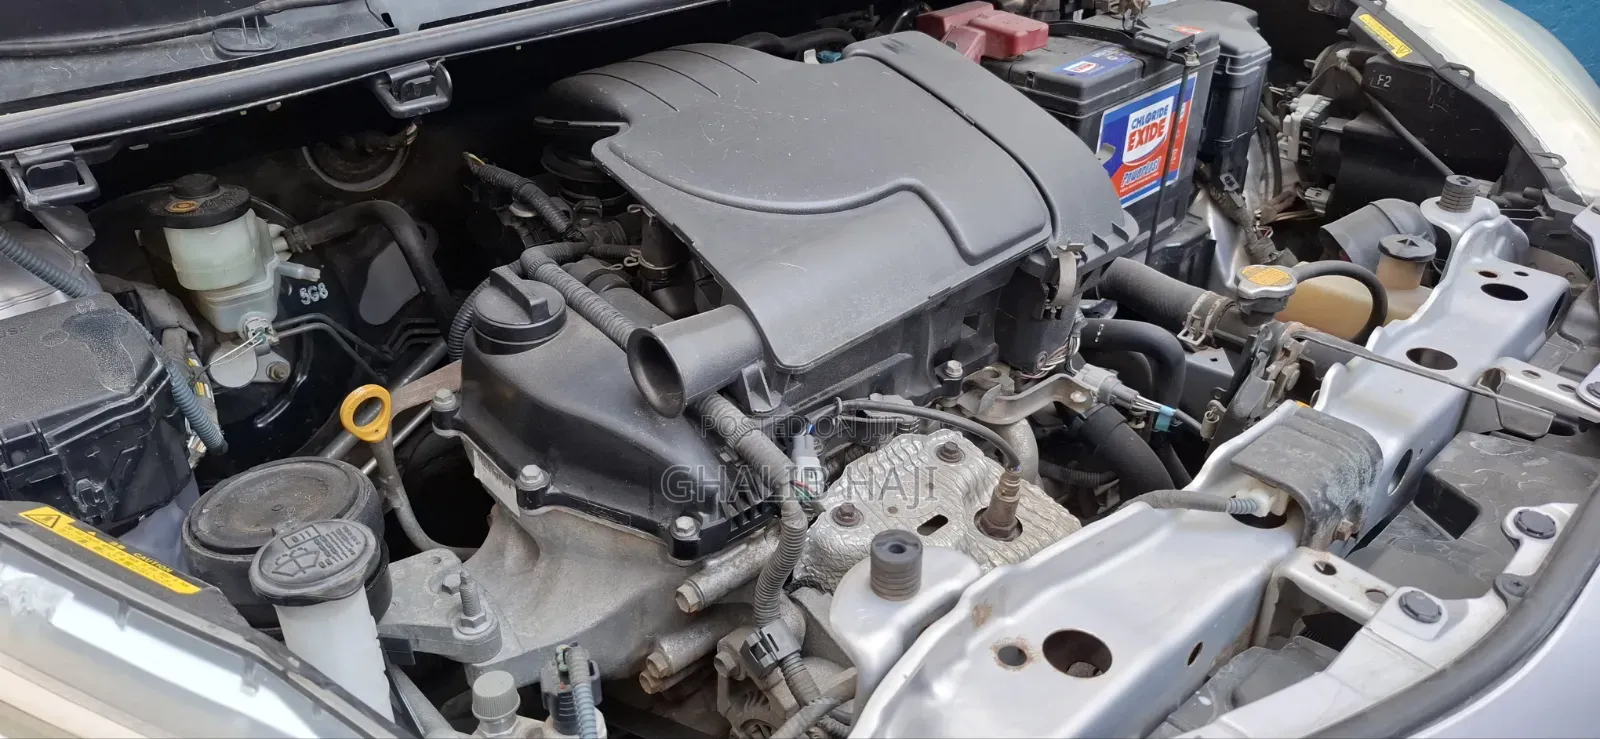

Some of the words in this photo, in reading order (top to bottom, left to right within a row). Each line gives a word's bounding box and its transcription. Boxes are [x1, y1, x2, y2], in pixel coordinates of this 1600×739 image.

[1377, 74, 1393, 88] F2
[1131, 104, 1170, 129] CHLORIDE
[1126, 116, 1167, 153] EXIDE
[133, 552, 174, 574] CAUTION
